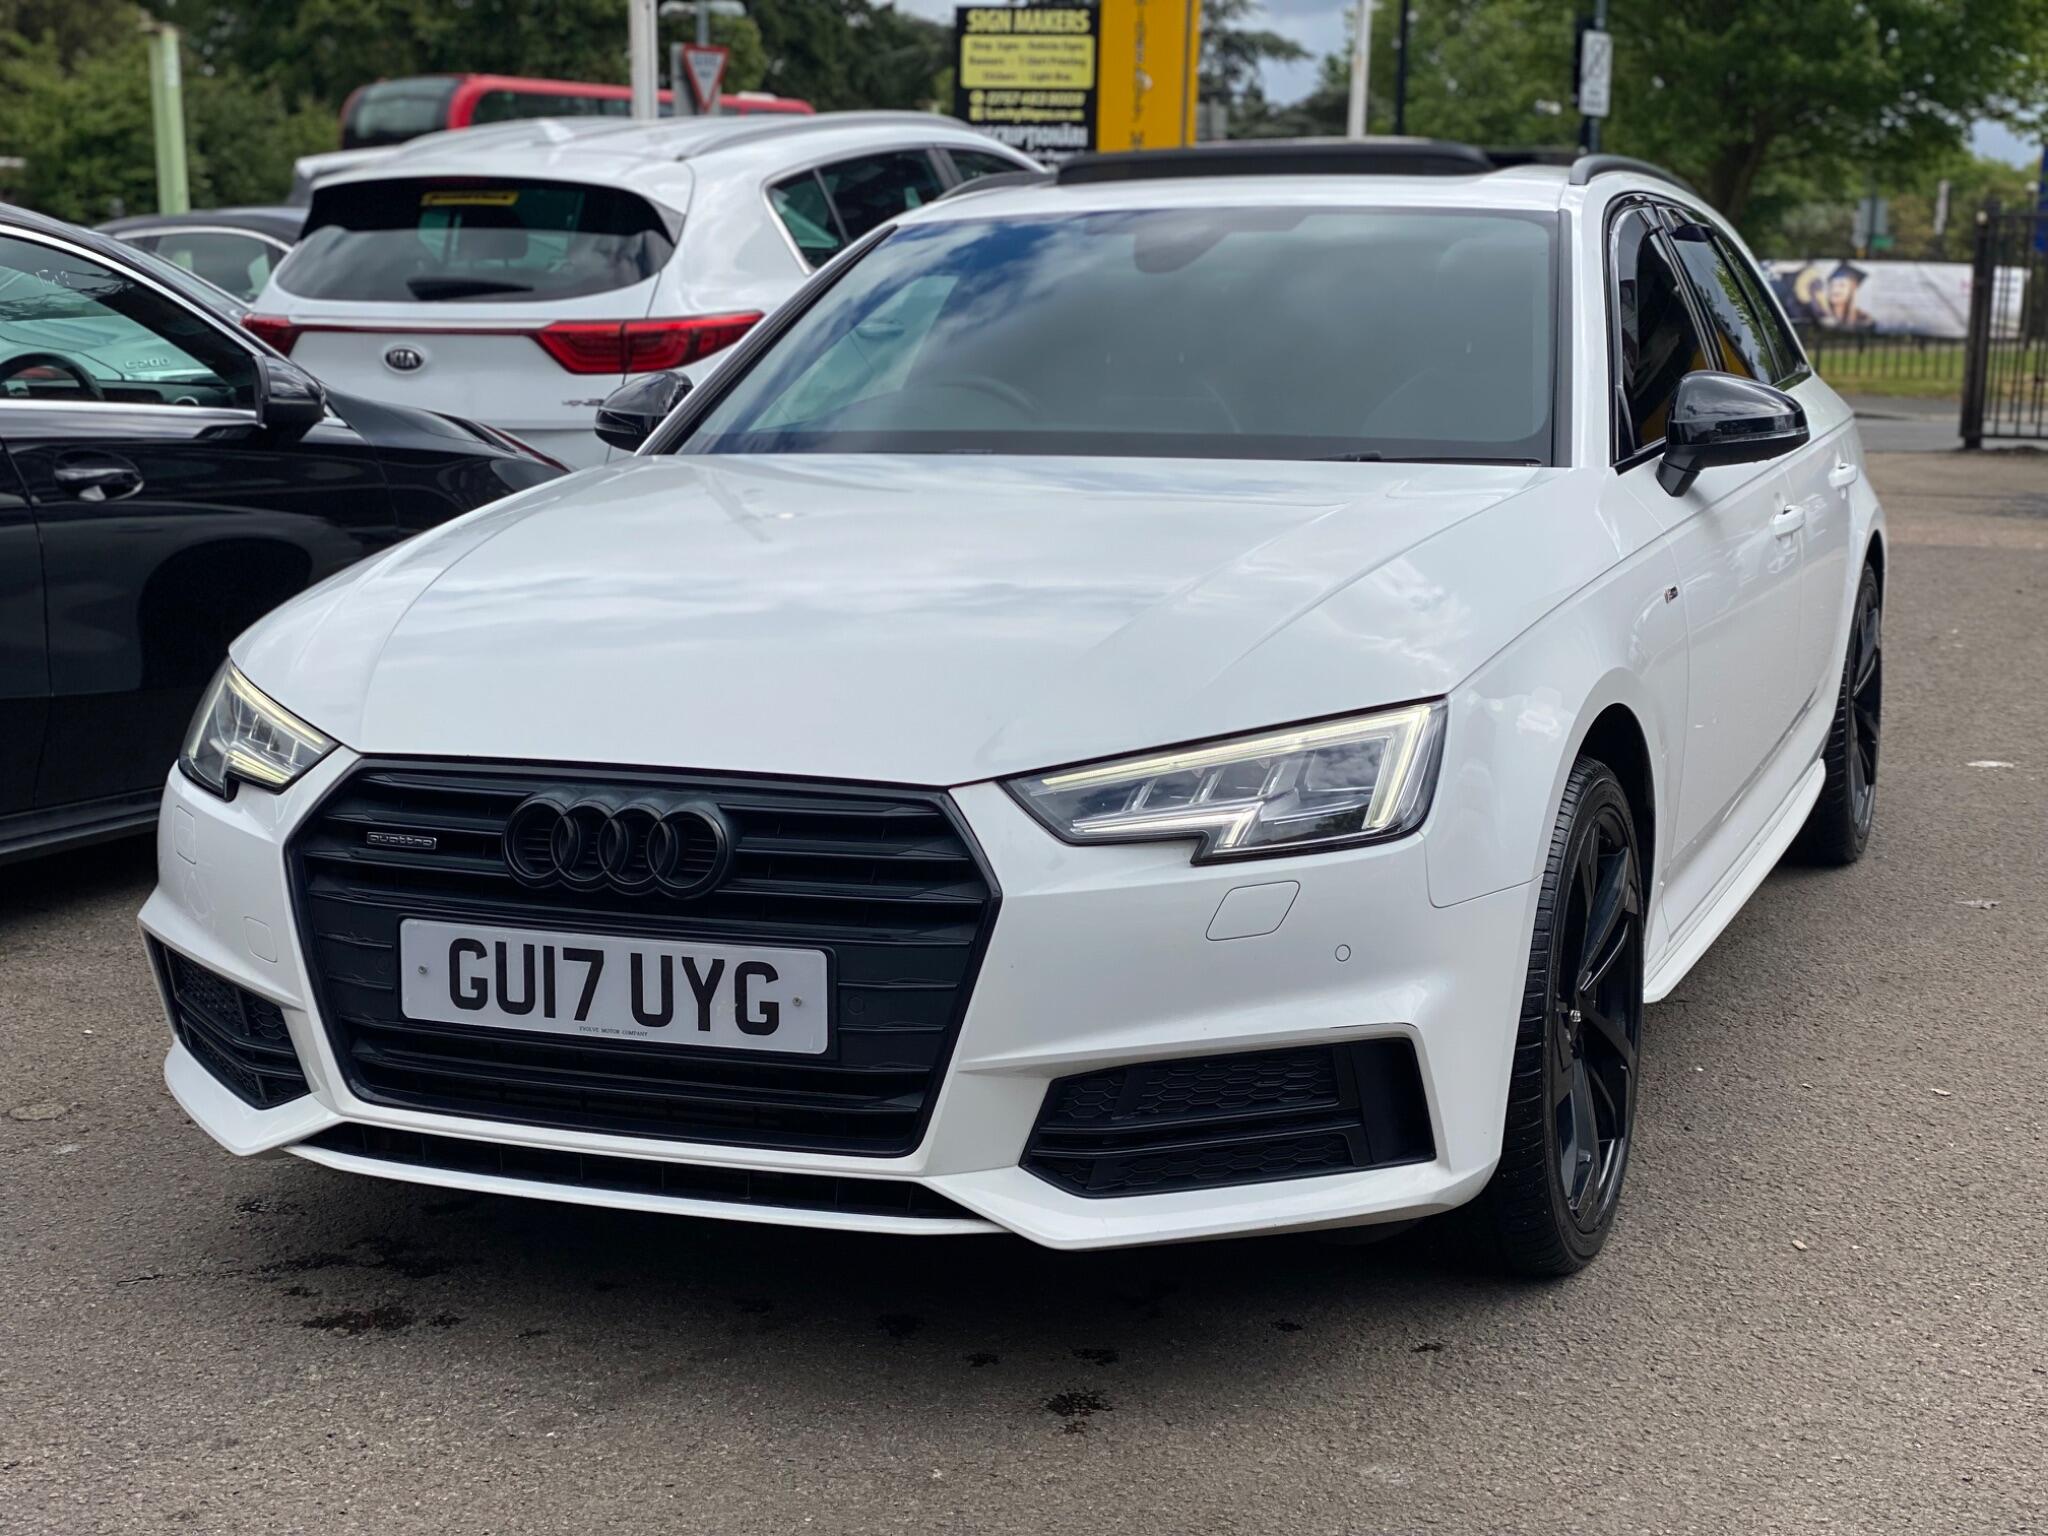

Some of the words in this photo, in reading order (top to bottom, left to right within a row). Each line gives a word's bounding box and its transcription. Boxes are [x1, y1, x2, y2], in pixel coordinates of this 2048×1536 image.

[966, 9, 1012, 32] SIGN
[1014, 9, 1090, 32] MAKERS
[448, 937, 605, 1022] GU17
[630, 952, 780, 1036] UYG
